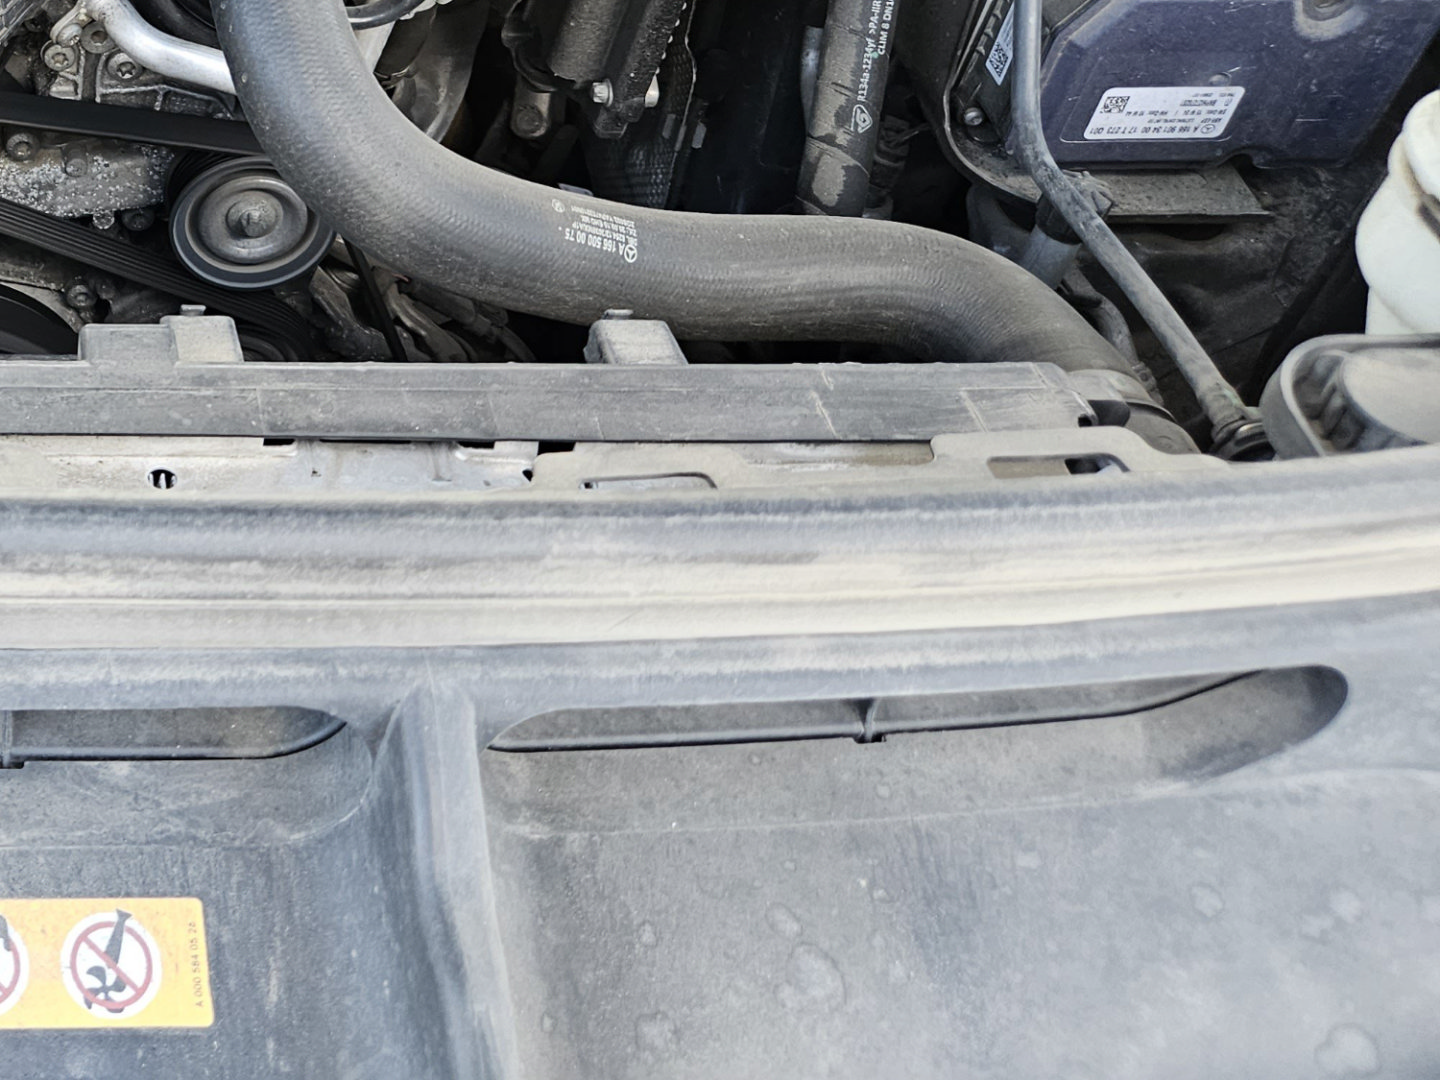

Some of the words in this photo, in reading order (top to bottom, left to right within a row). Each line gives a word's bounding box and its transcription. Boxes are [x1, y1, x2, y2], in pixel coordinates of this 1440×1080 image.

[881, 22, 891, 30] 8
[877, 31, 889, 56] CLIM
[564, 227, 575, 241] 75
[576, 230, 587, 244] 00
[587, 234, 602, 249] 500
[602, 238, 617, 254] 166
[618, 242, 626, 256] A
[189, 937, 198, 951] 05
[192, 976, 203, 997] 000
